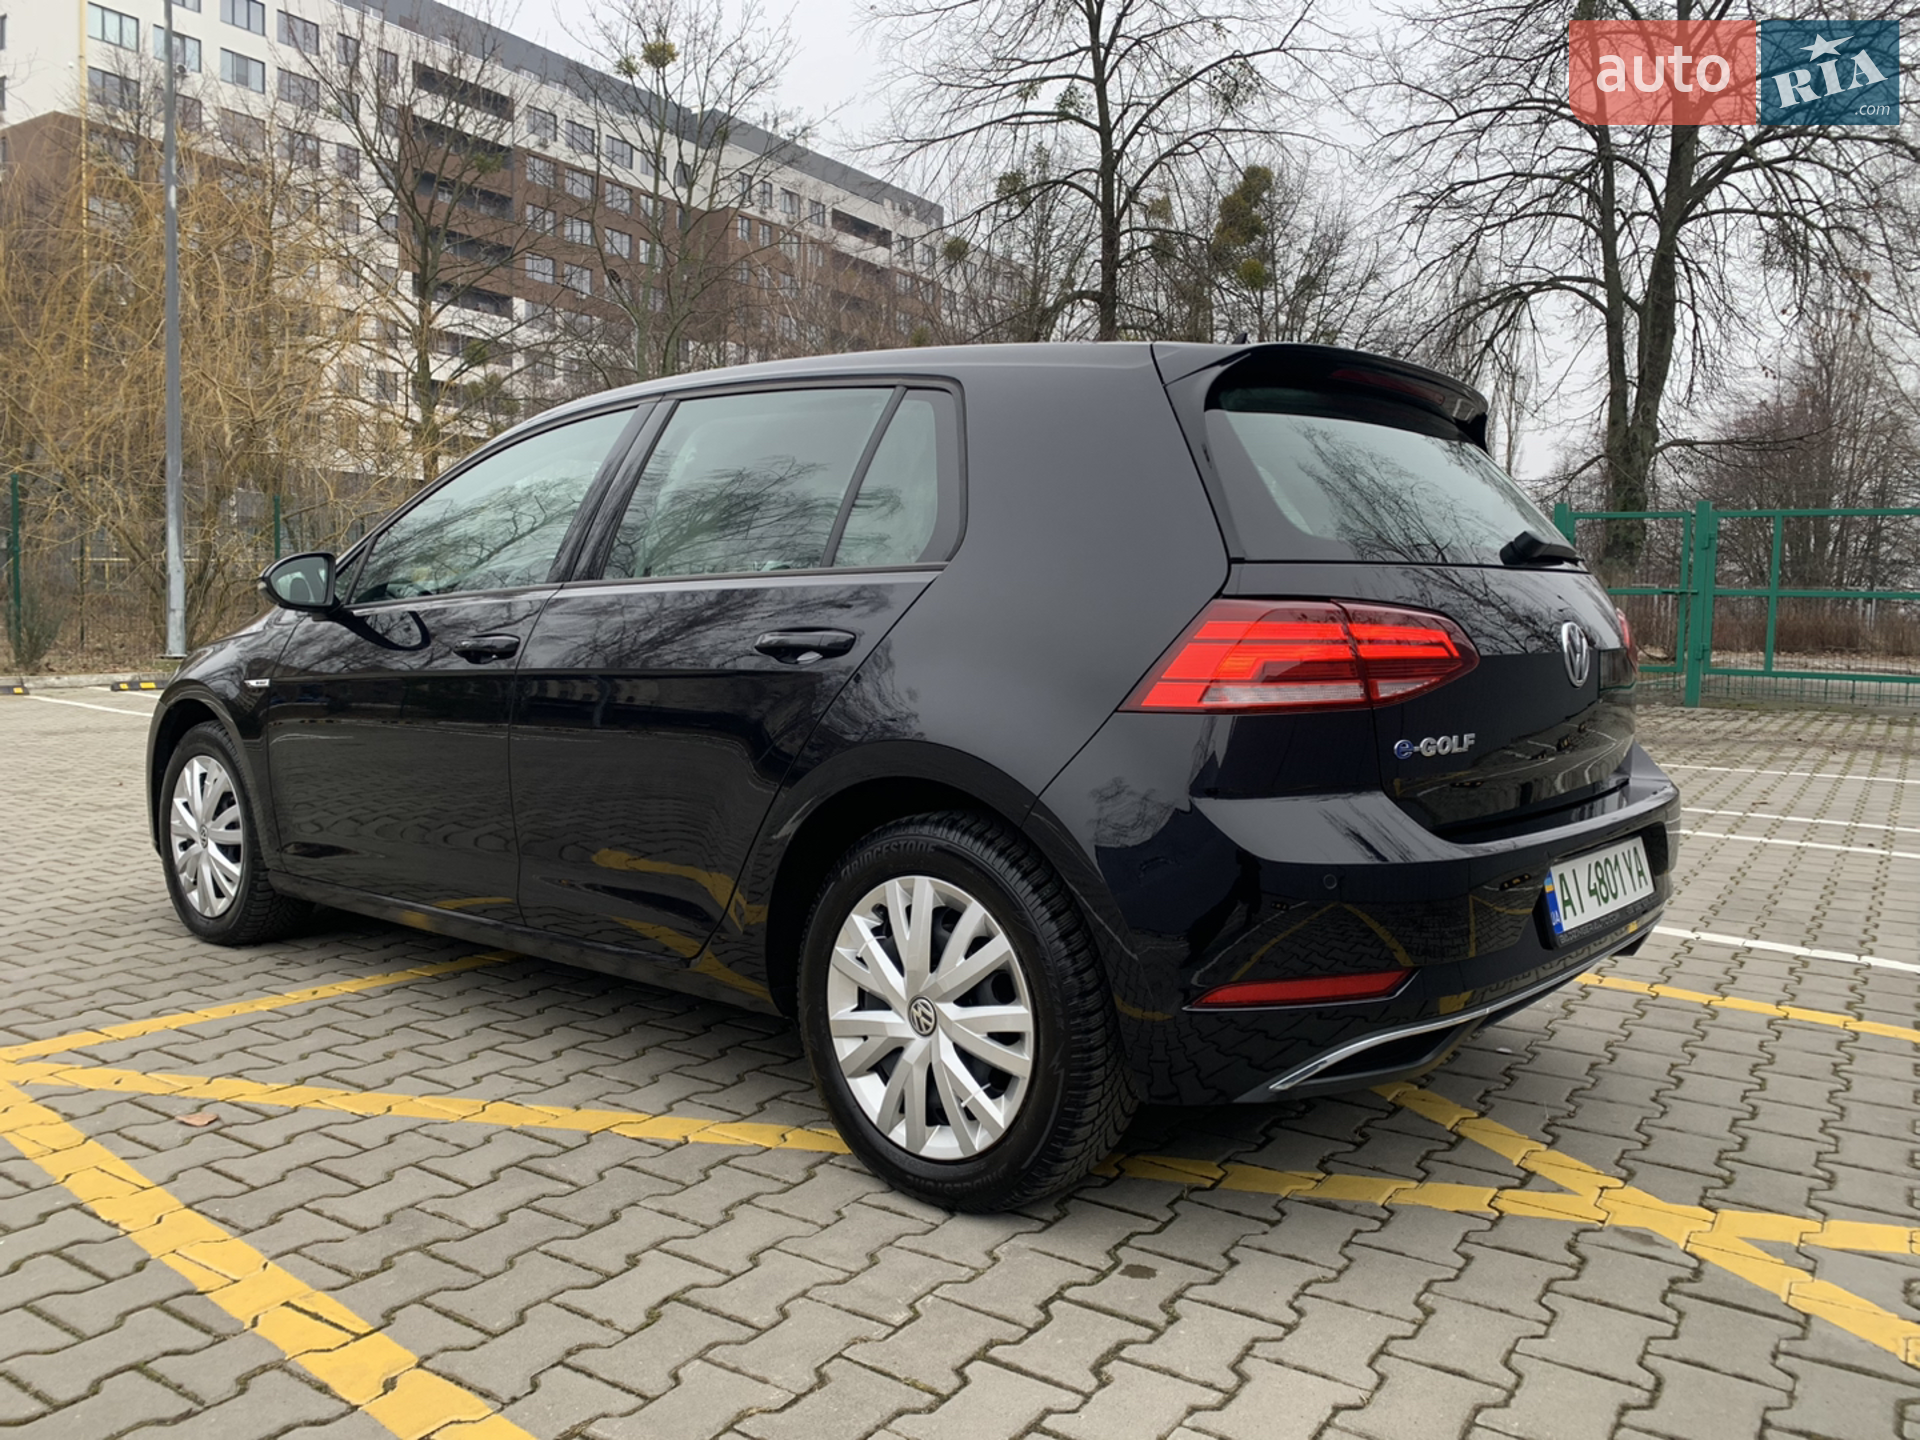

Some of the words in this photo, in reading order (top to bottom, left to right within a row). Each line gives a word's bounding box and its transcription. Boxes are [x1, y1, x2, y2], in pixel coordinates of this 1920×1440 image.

[1394, 733, 1476, 760] e-GOLF
[1558, 868, 1585, 921] AI
[1587, 853, 1627, 907] 4801
[1621, 846, 1649, 893] YA
